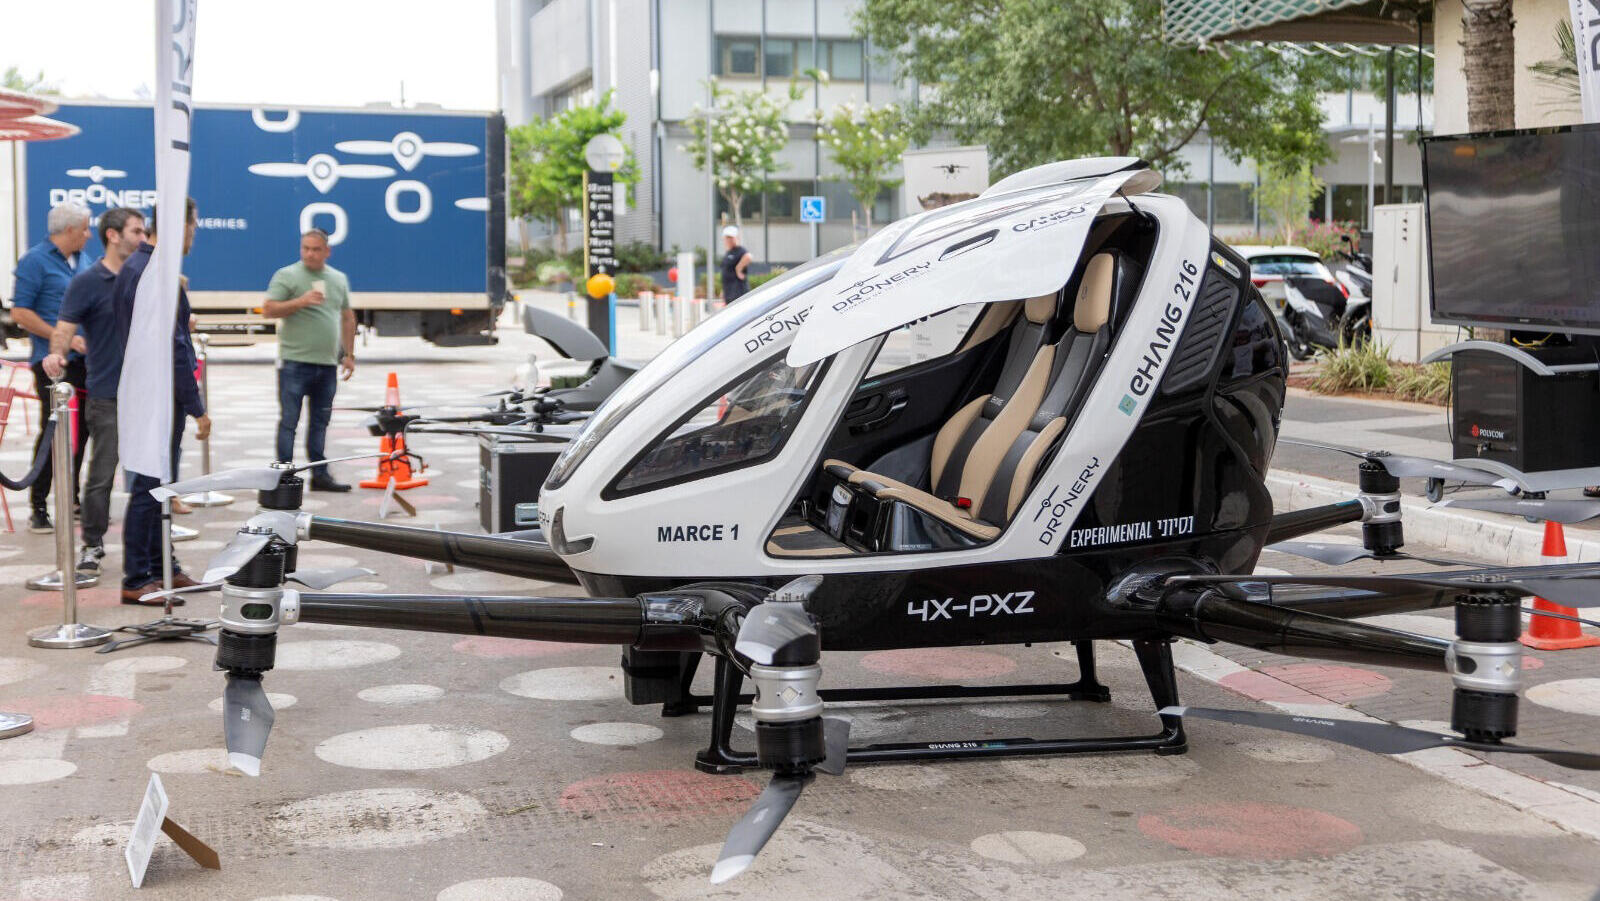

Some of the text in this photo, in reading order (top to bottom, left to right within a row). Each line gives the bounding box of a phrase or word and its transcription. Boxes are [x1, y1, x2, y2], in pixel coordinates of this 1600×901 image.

[49, 184, 157, 208] DRONER
[832, 261, 931, 312] DRONERY
[1173, 259, 1198, 303] 216
[1479, 428, 1505, 440] POLYCOM
[1039, 456, 1101, 546] DRONERY
[657, 523, 739, 542] MARCE 1
[1070, 521, 1153, 548] EXPERIMENTAL
[907, 590, 1036, 622] 4X-PXZ
